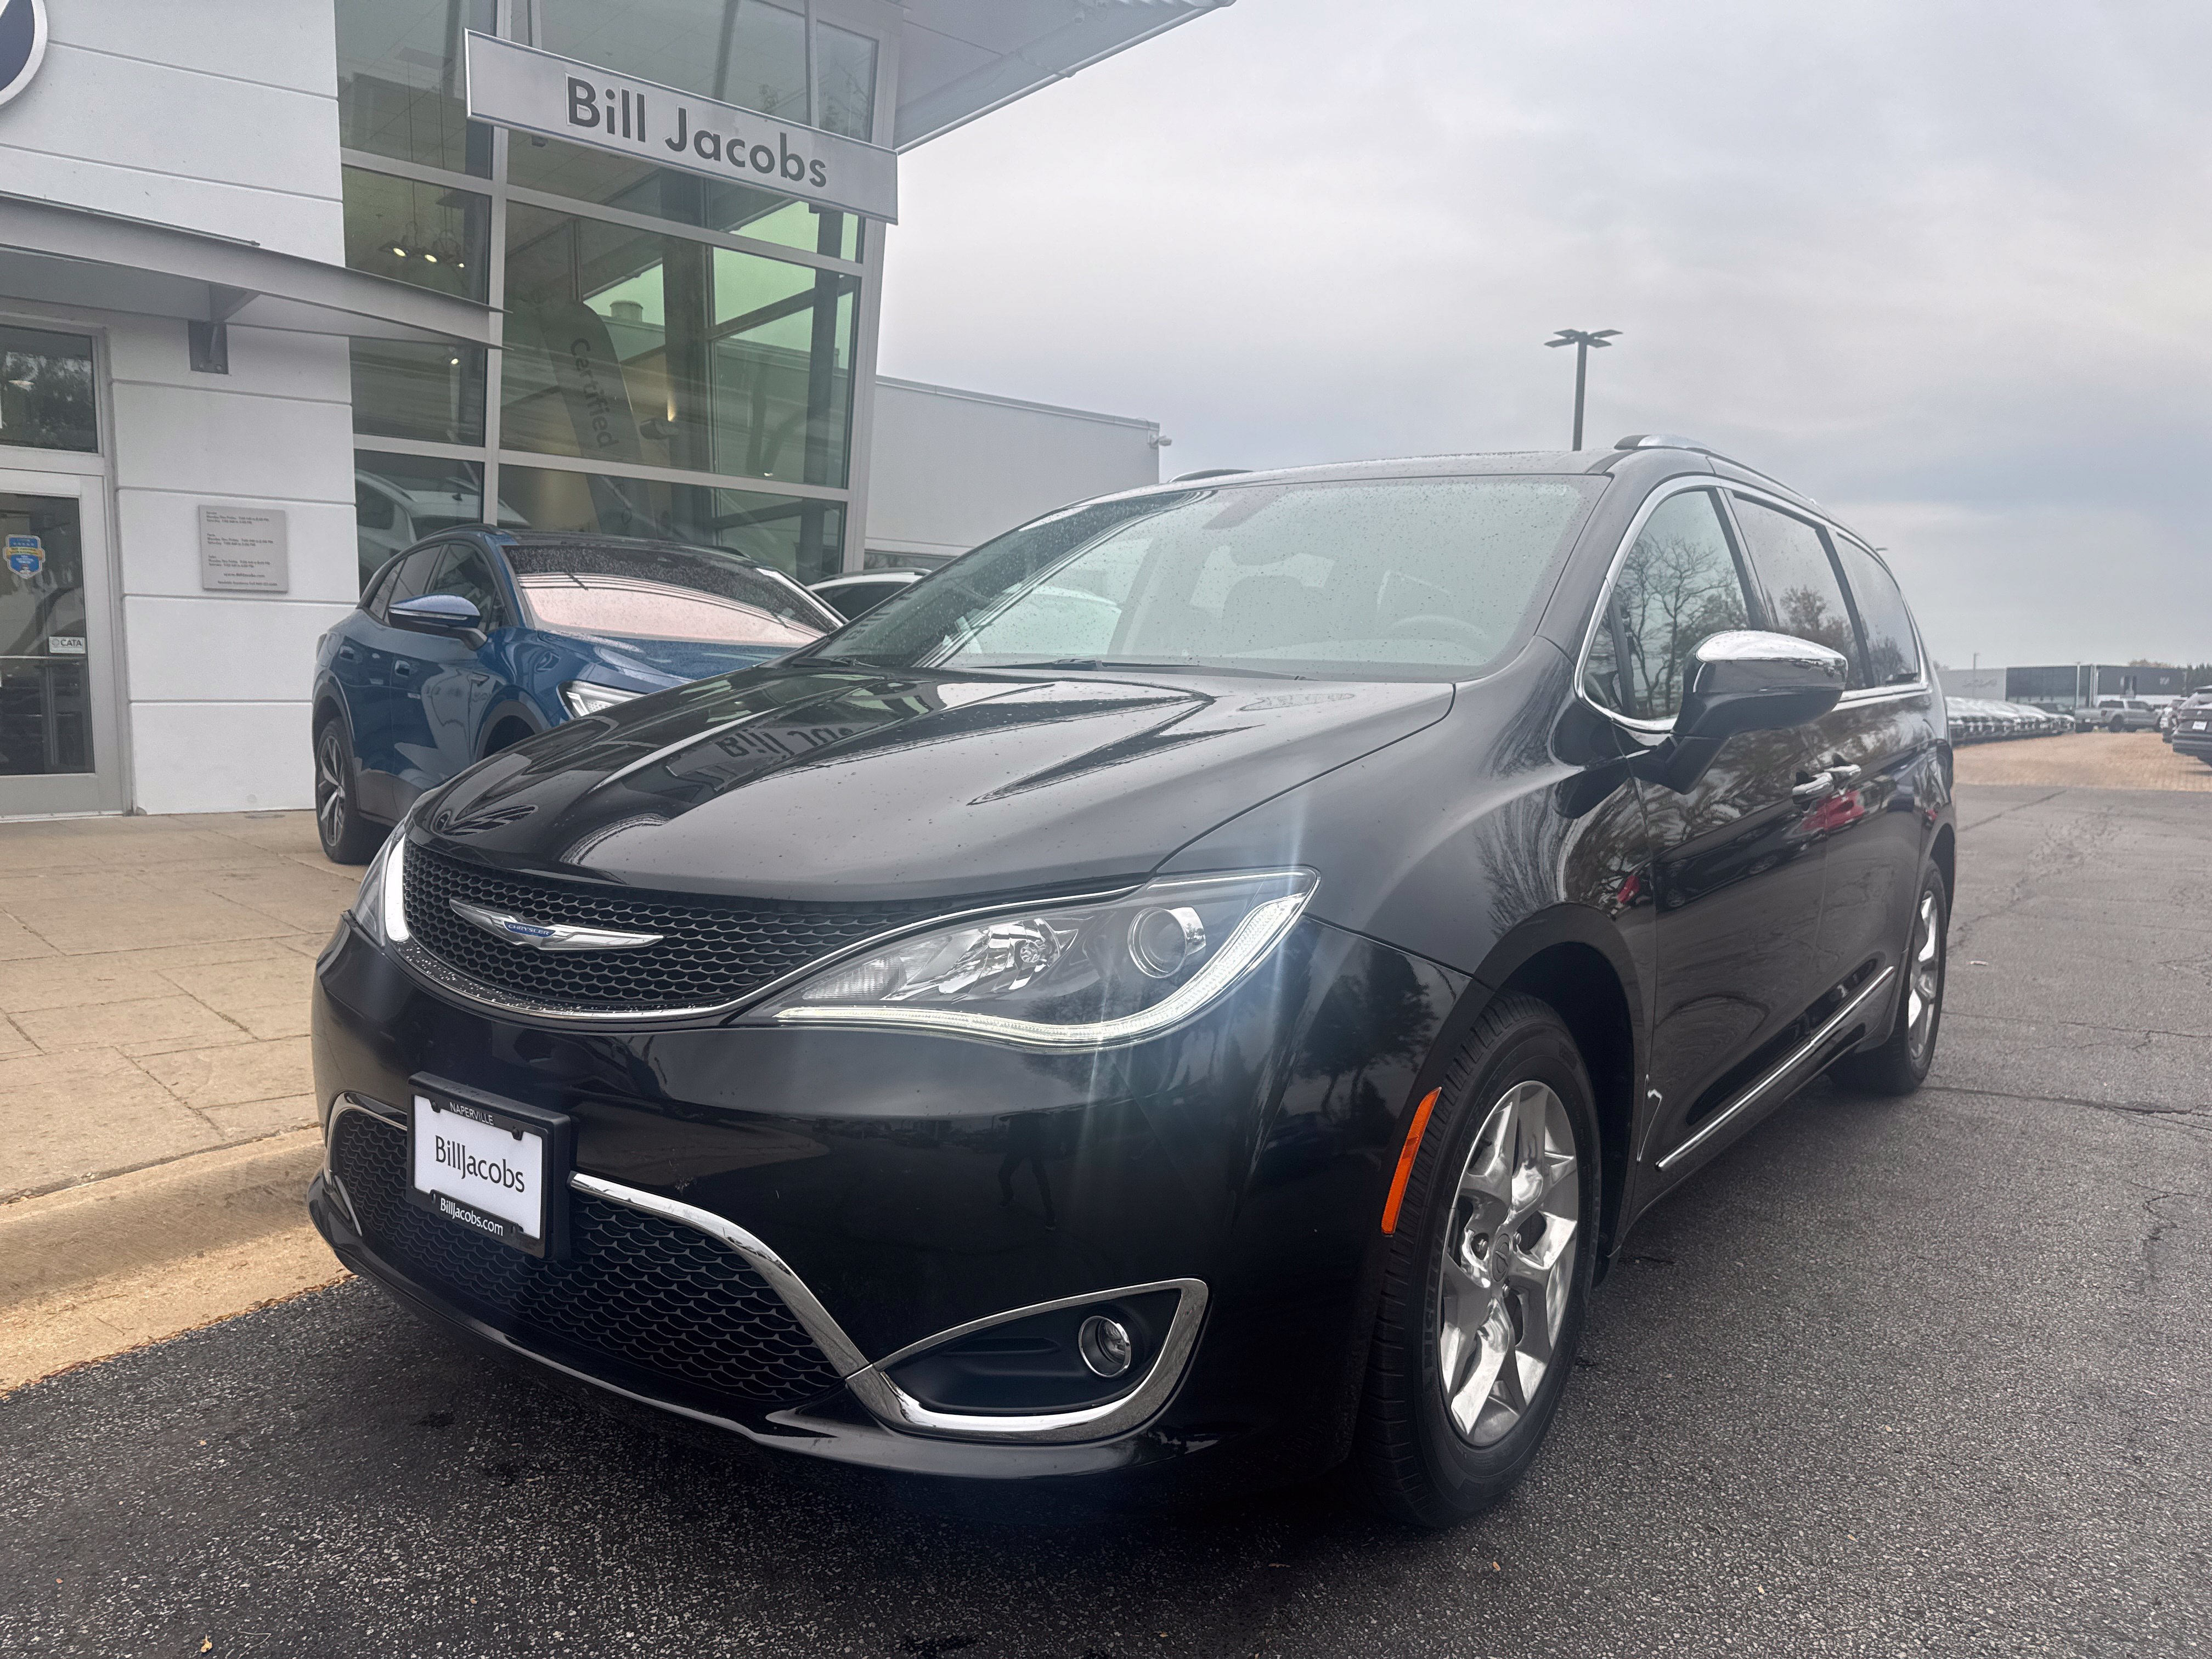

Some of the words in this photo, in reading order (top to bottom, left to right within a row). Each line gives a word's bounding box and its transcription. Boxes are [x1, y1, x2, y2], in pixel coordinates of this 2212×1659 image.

[567, 76, 646, 143] Bill
[665, 108, 826, 188] Jacobs
[571, 337, 620, 448] Certified
[508, 924, 549, 935] CHRYSLER
[450, 1102, 494, 1125] NAPERVILLE
[435, 1135, 525, 1193] BillJacobs
[440, 1197, 504, 1236] BillJacobs.com
